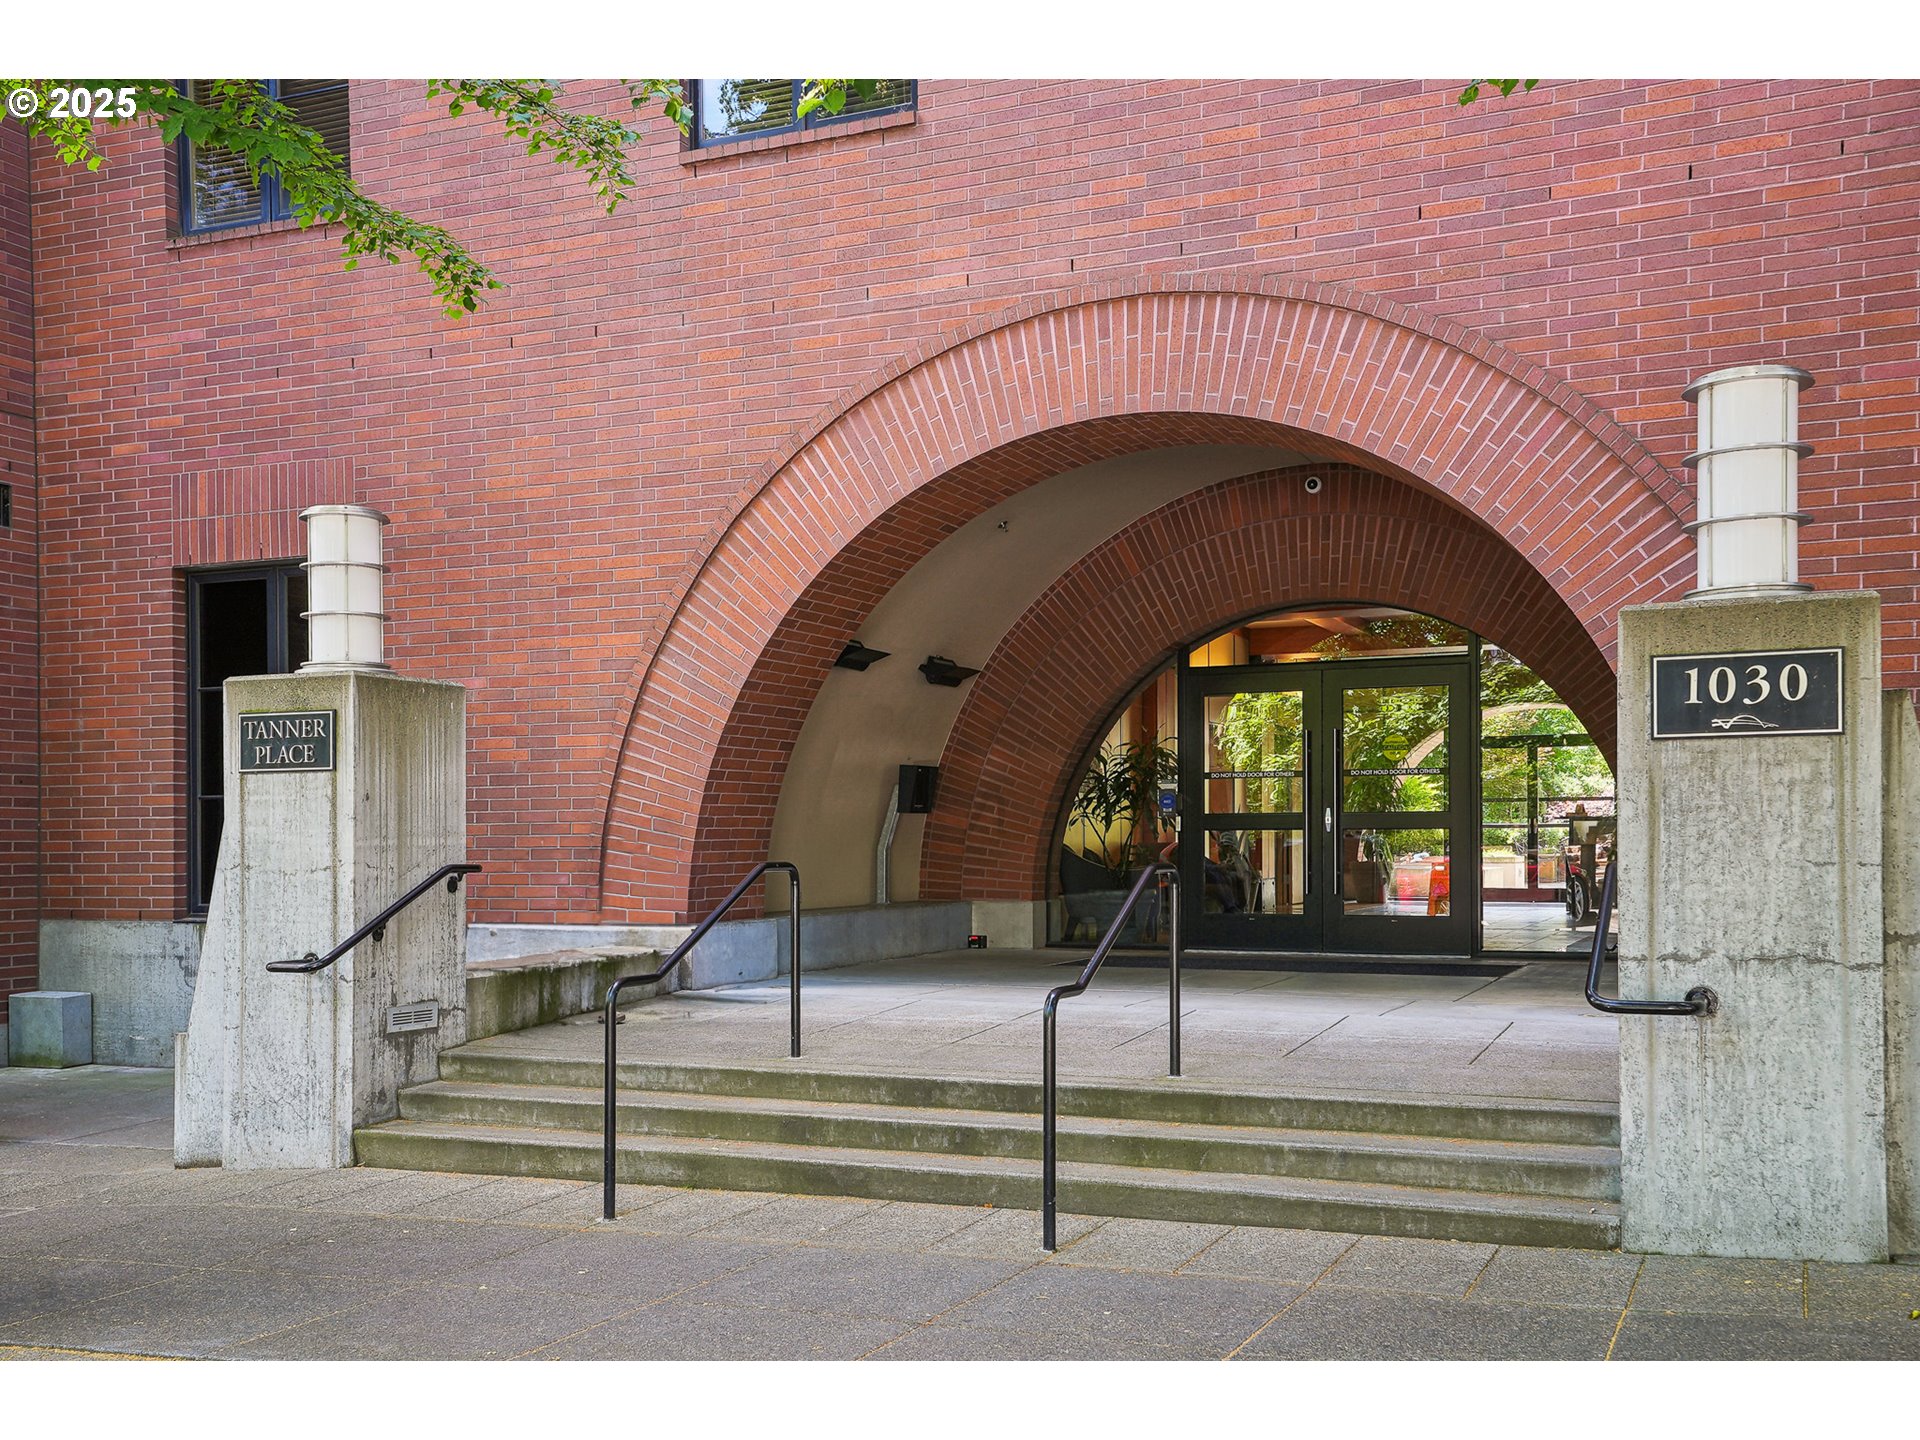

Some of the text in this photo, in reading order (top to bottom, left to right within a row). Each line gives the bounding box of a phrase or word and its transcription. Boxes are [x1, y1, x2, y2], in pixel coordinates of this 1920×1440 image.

[1684, 663, 1808, 705] 1030
[243, 718, 326, 740] TANNER
[254, 744, 316, 765] PLACE
